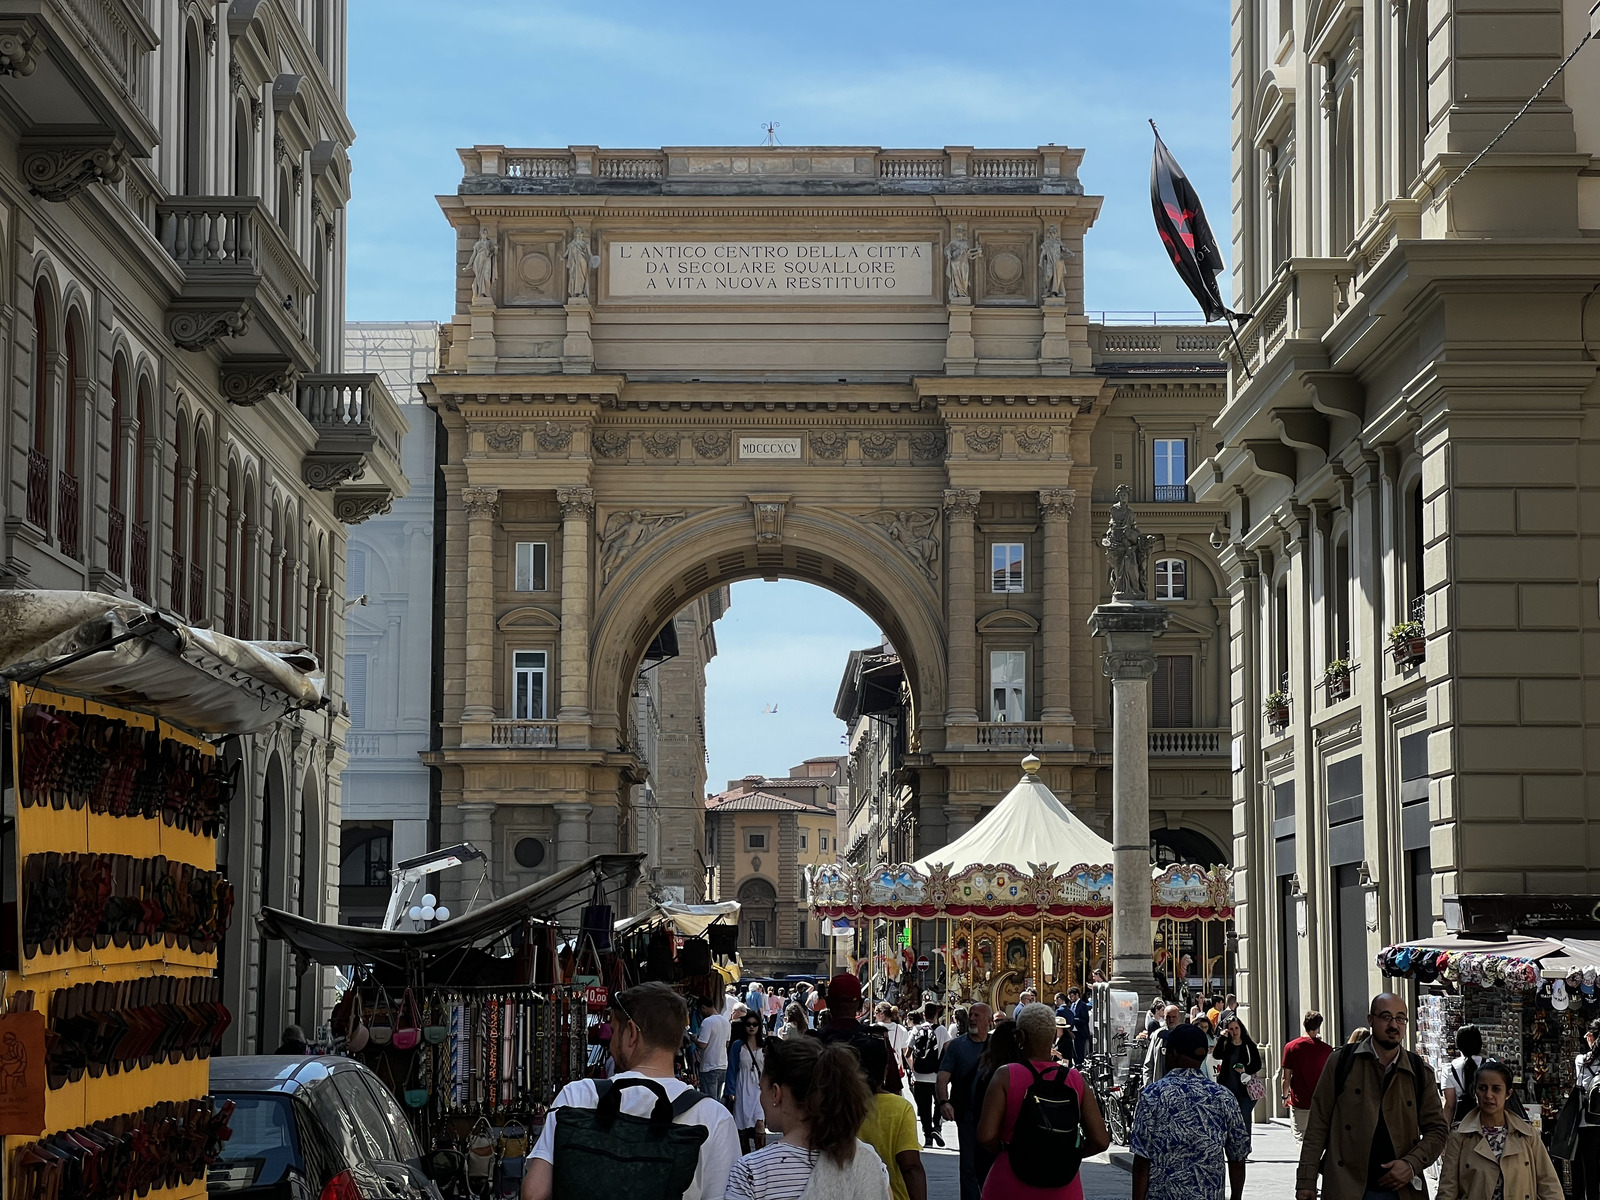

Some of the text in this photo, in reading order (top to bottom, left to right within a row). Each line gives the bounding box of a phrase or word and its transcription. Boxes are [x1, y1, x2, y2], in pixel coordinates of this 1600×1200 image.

[640, 246, 707, 258] ANTICO
[714, 246, 789, 258] CENTRO
[797, 246, 858, 258] DELLA
[646, 261, 896, 274] DA SECOLARE SQUALLORE
[646, 277, 896, 289] A VITA NUOVA RESTITUITO
[742, 443, 797, 454] MDCCCXCV
[585, 989, 607, 1003] 10,00
